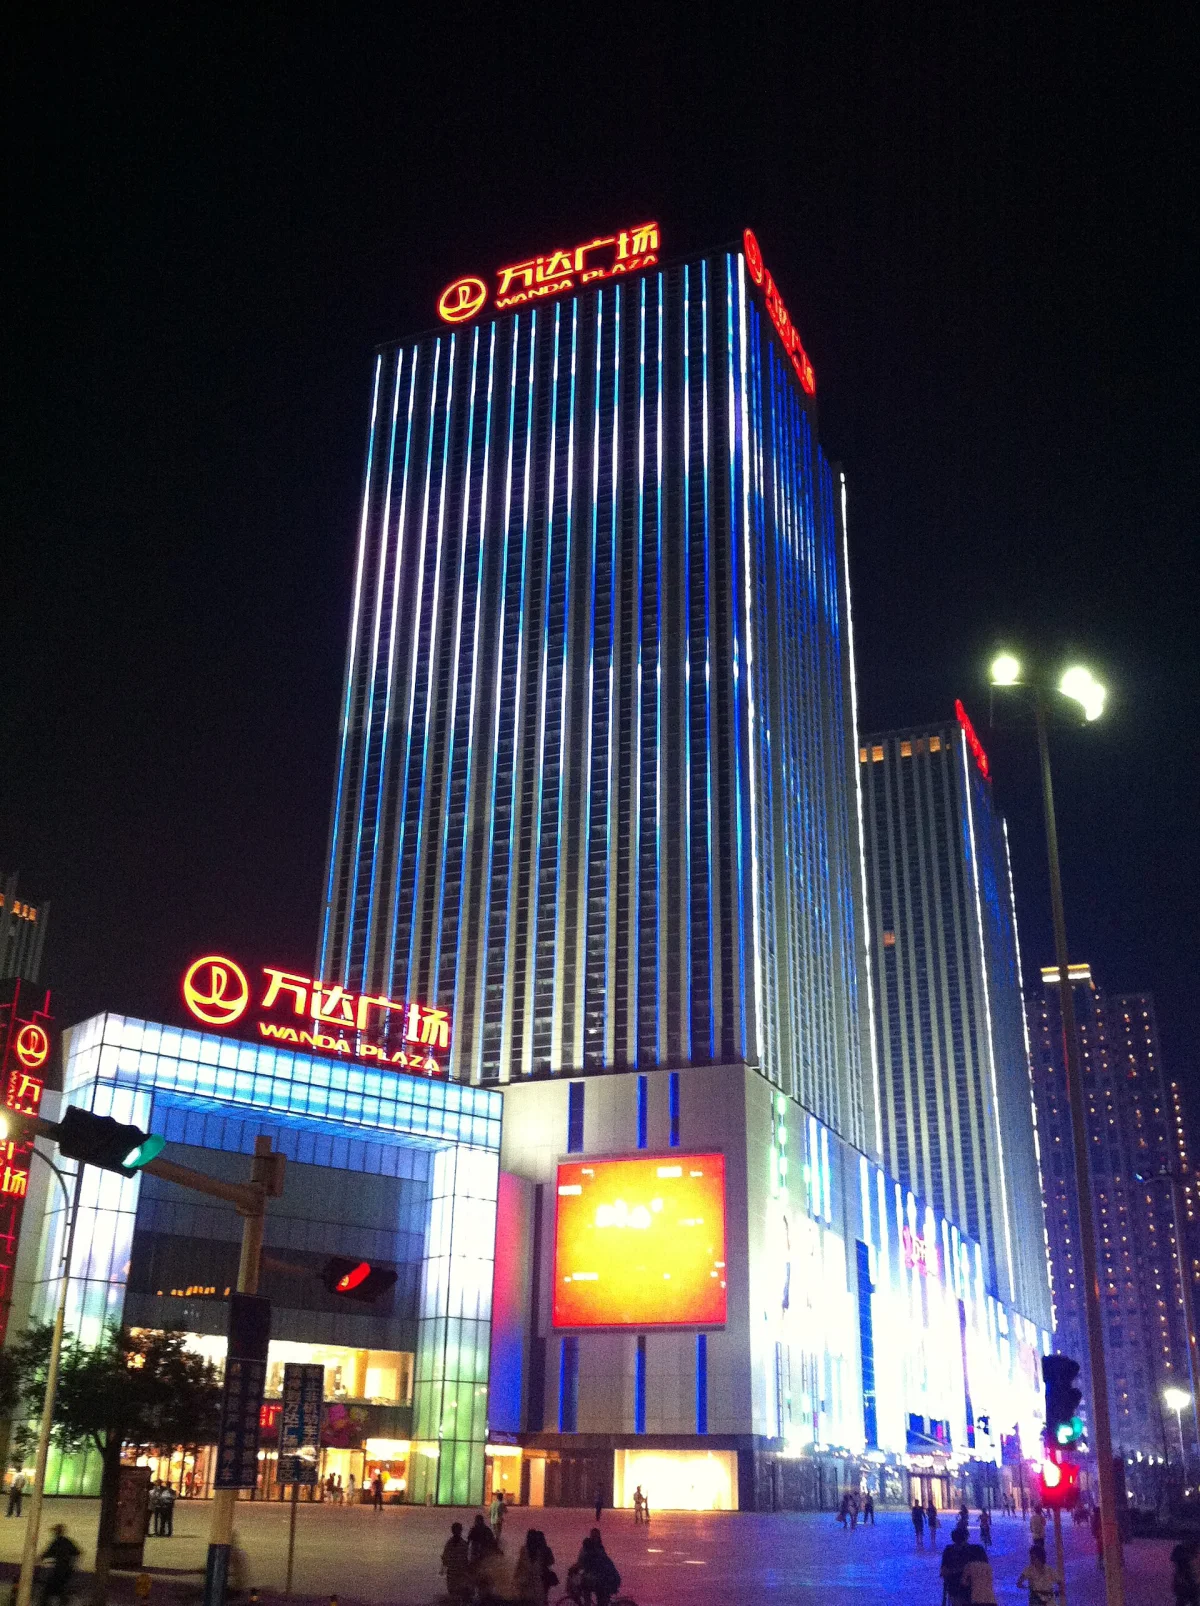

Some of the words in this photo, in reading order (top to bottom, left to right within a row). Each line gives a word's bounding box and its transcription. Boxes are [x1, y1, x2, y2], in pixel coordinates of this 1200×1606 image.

[496, 279, 574, 308] WANDA
[581, 255, 657, 283] PLAZA
[497, 221, 659, 295] 万达广场
[261, 967, 450, 1049] 万达广场
[259, 1021, 352, 1054] WANDA
[359, 1043, 441, 1073] PLAZA
